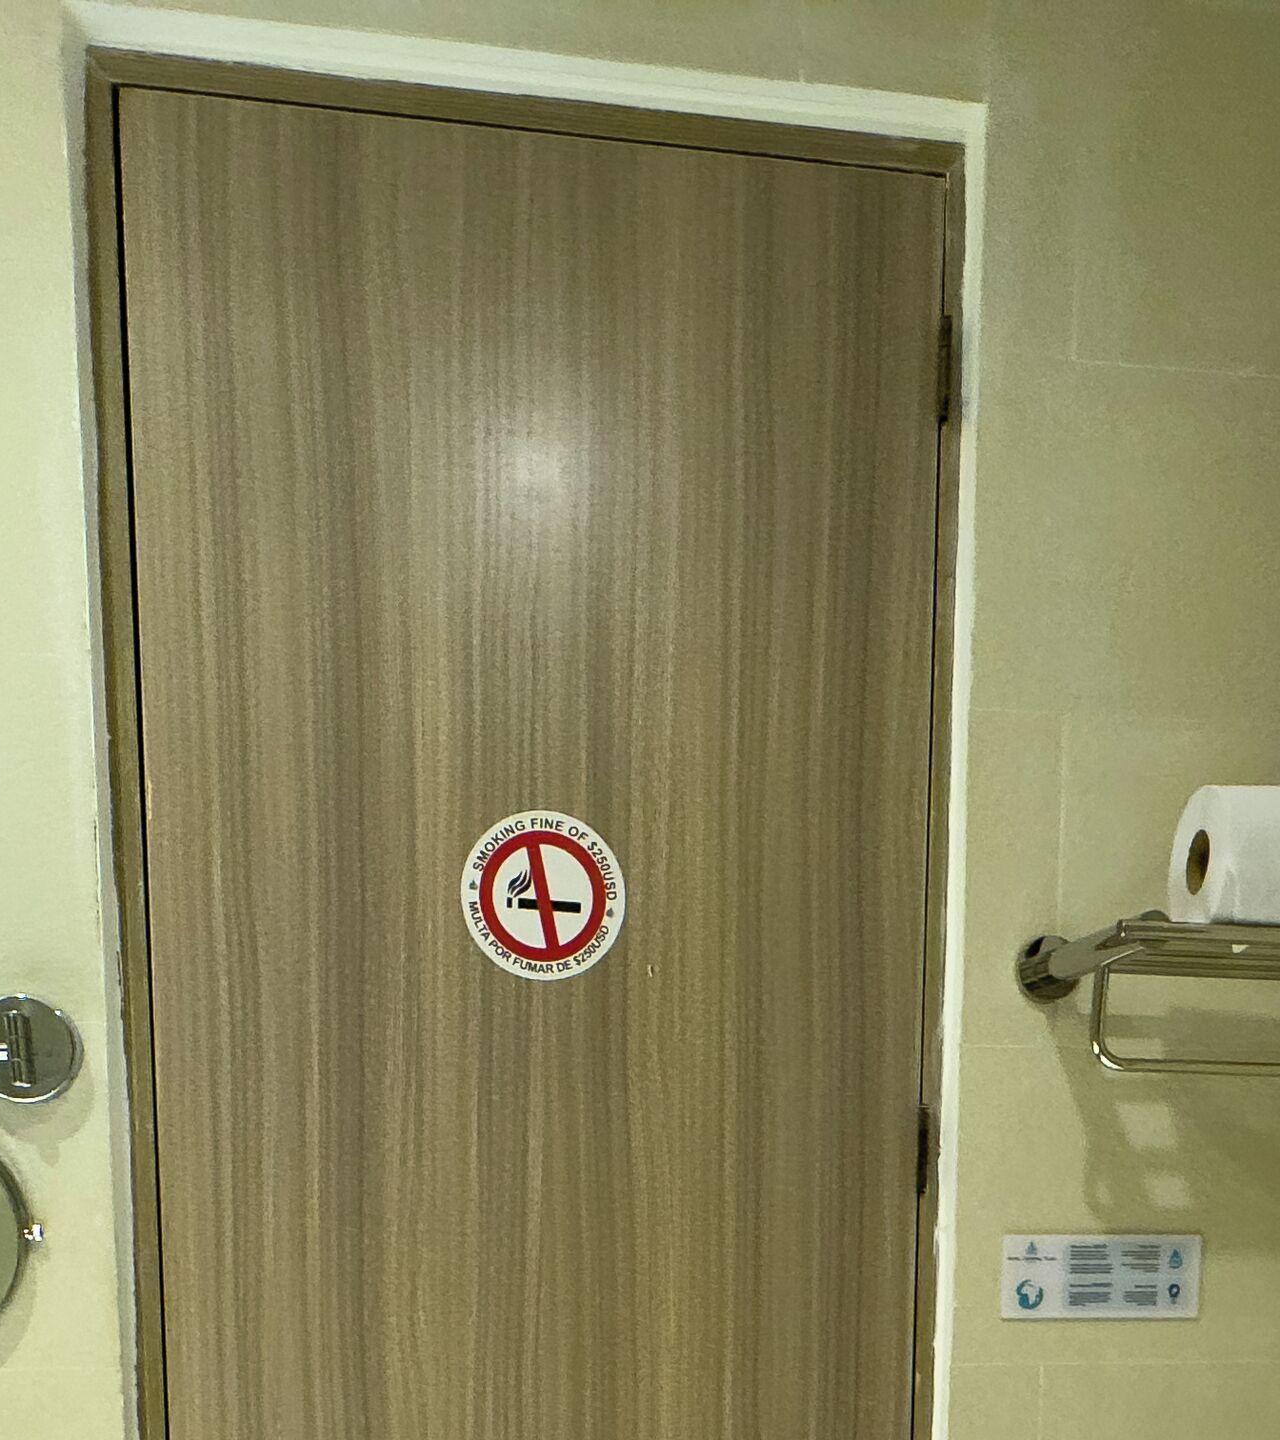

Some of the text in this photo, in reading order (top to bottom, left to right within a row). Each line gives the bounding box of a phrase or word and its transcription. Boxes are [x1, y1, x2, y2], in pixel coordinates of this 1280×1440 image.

[473, 817, 618, 901] SMOKING FINE OF $250USD
[468, 901, 609, 974] MULTA POR FUMAR DE $250USD
